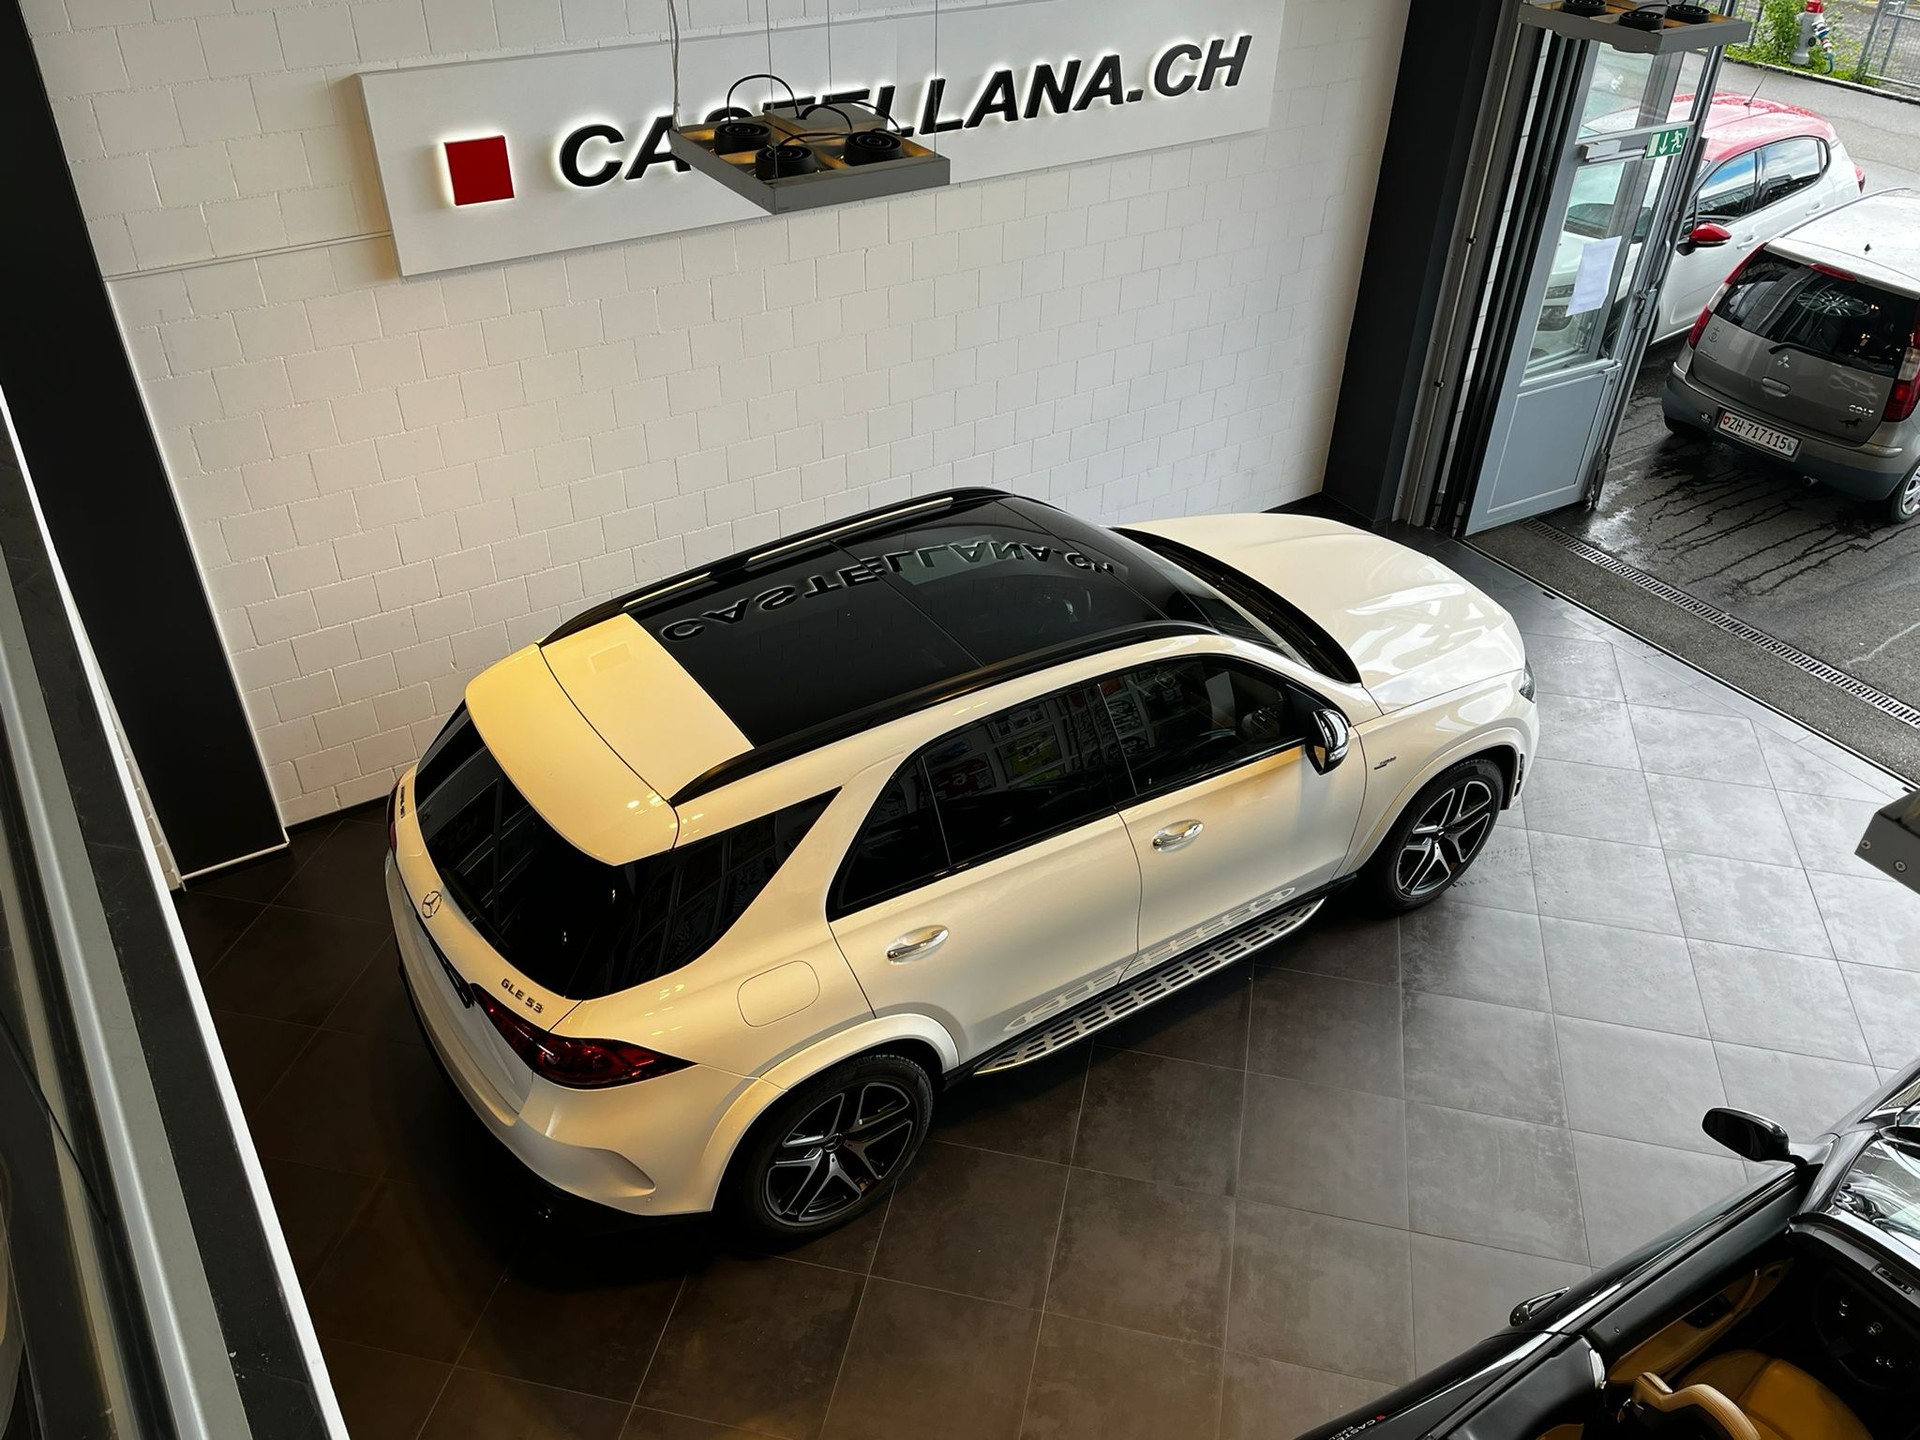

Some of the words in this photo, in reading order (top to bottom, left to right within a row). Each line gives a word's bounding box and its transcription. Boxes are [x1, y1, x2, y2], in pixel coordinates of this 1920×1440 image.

[559, 34, 1252, 187] CALLANA.CH
[501, 978, 524, 1001] GLE
[525, 996, 544, 1014] 53
